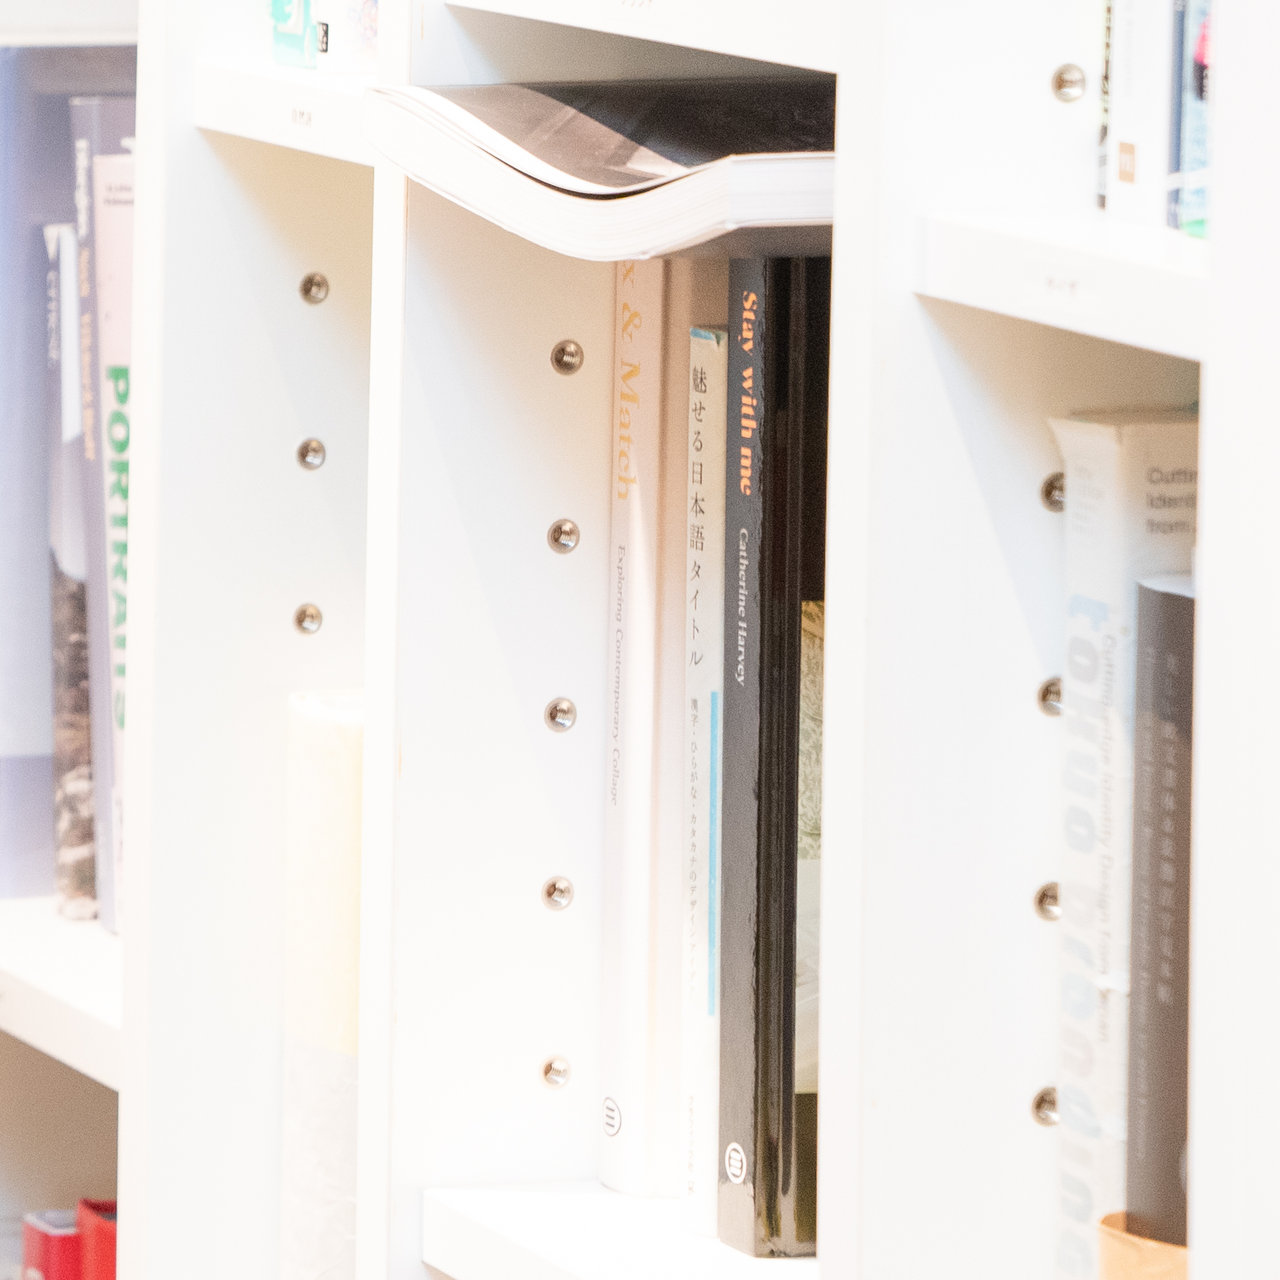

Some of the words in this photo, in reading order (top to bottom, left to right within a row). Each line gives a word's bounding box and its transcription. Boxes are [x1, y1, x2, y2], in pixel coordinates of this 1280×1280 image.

[622, 303, 642, 342] &
[741, 291, 757, 357] Stay
[618, 359, 641, 500] Match
[740, 366, 757, 444] with
[739, 451, 752, 496] me
[688, 366, 708, 668] 魅せる日本語タイトル
[615, 544, 627, 622] Exploring
[737, 527, 750, 618] Catherine
[611, 628, 625, 736] Contemporary
[735, 621, 748, 687] Harvey
[609, 747, 622, 806] Collage
